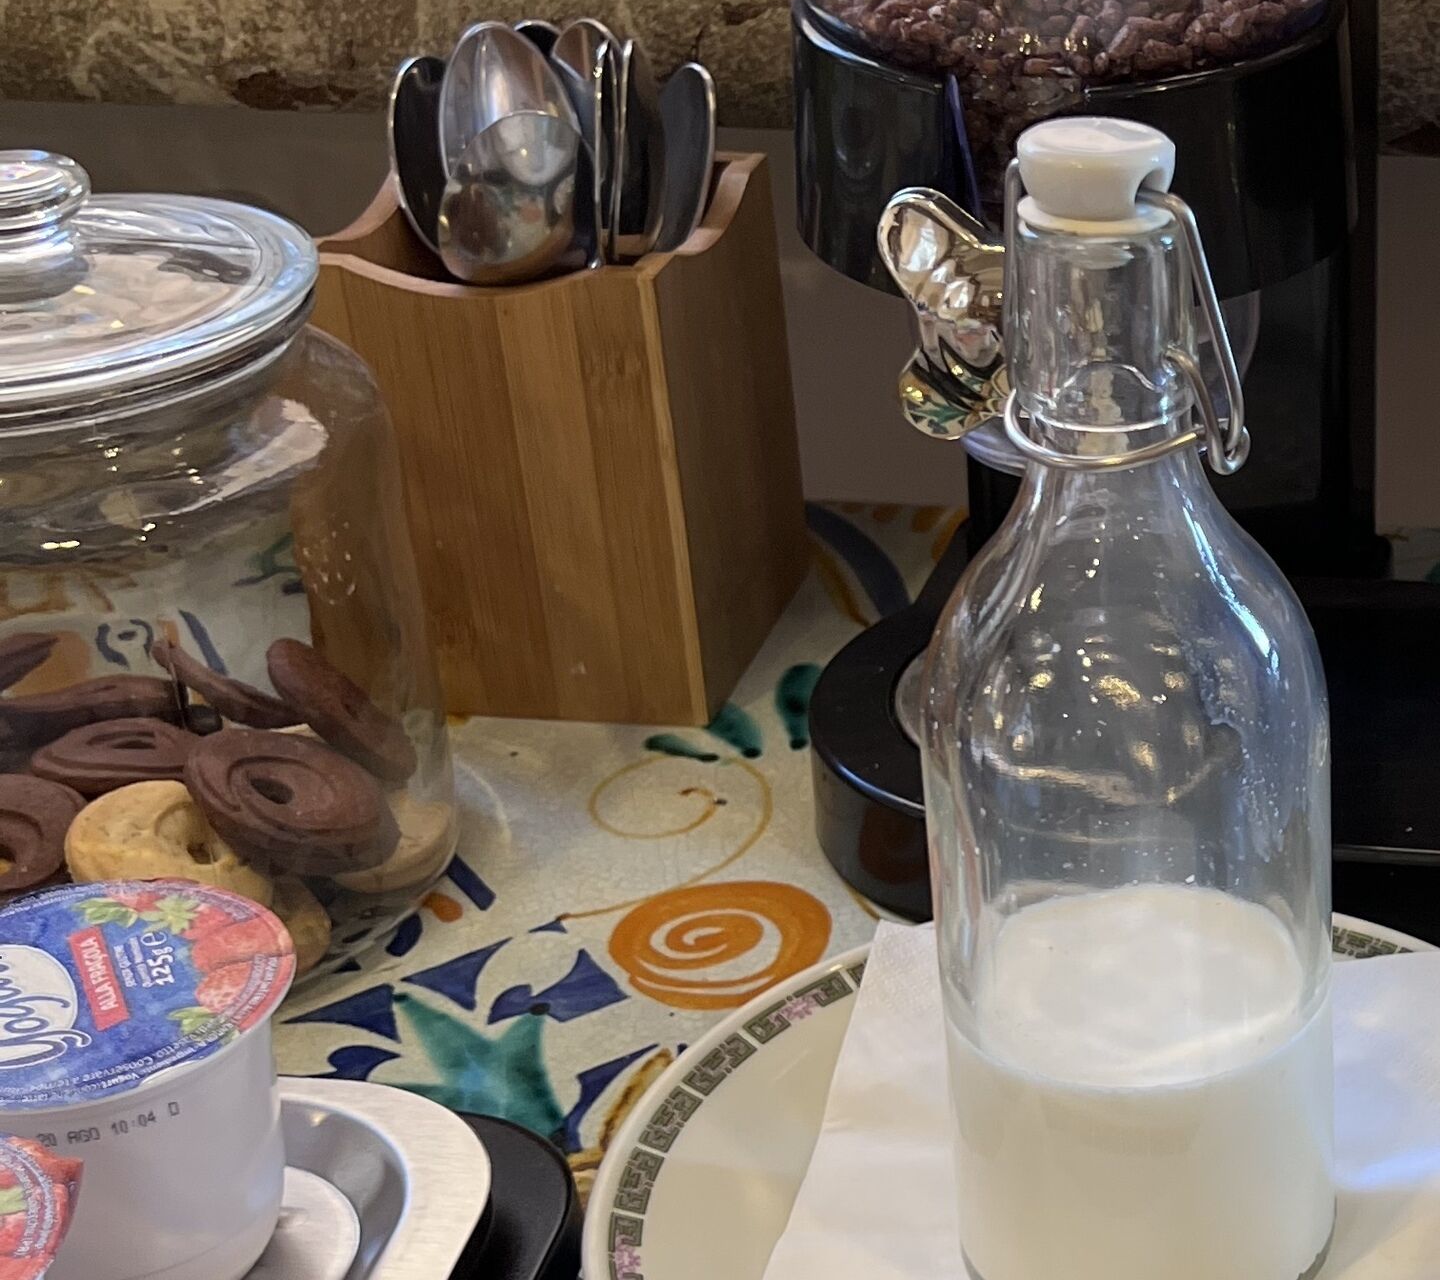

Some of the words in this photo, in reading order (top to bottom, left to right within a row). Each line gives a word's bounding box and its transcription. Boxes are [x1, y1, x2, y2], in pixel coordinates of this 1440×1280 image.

[147, 946, 175, 986] 125g
[95, 981, 119, 1011] ALLA
[67, 1127, 100, 1144] AGO
[111, 1111, 156, 1136] 10:04
